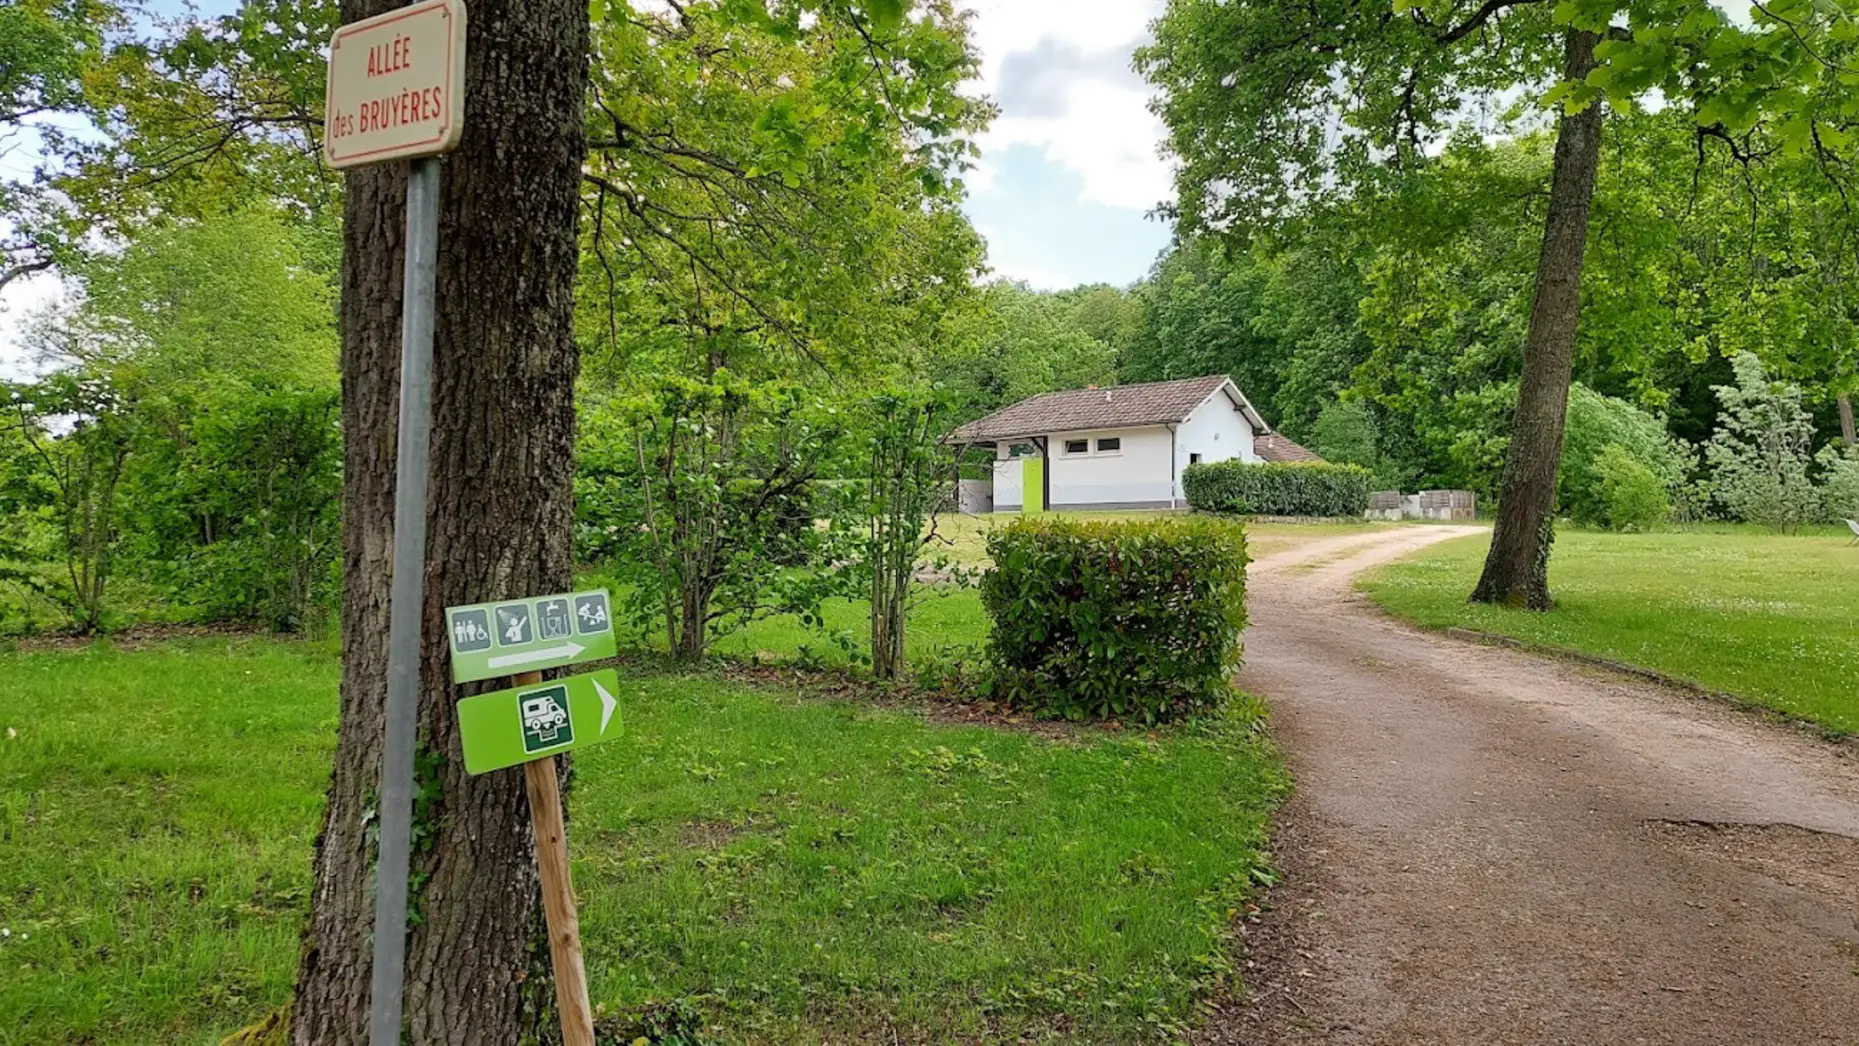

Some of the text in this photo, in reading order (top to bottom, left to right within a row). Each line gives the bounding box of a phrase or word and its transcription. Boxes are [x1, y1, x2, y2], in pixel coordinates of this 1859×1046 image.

[367, 33, 411, 78] ALLÉE
[333, 86, 441, 138] des BRUYÈRES
